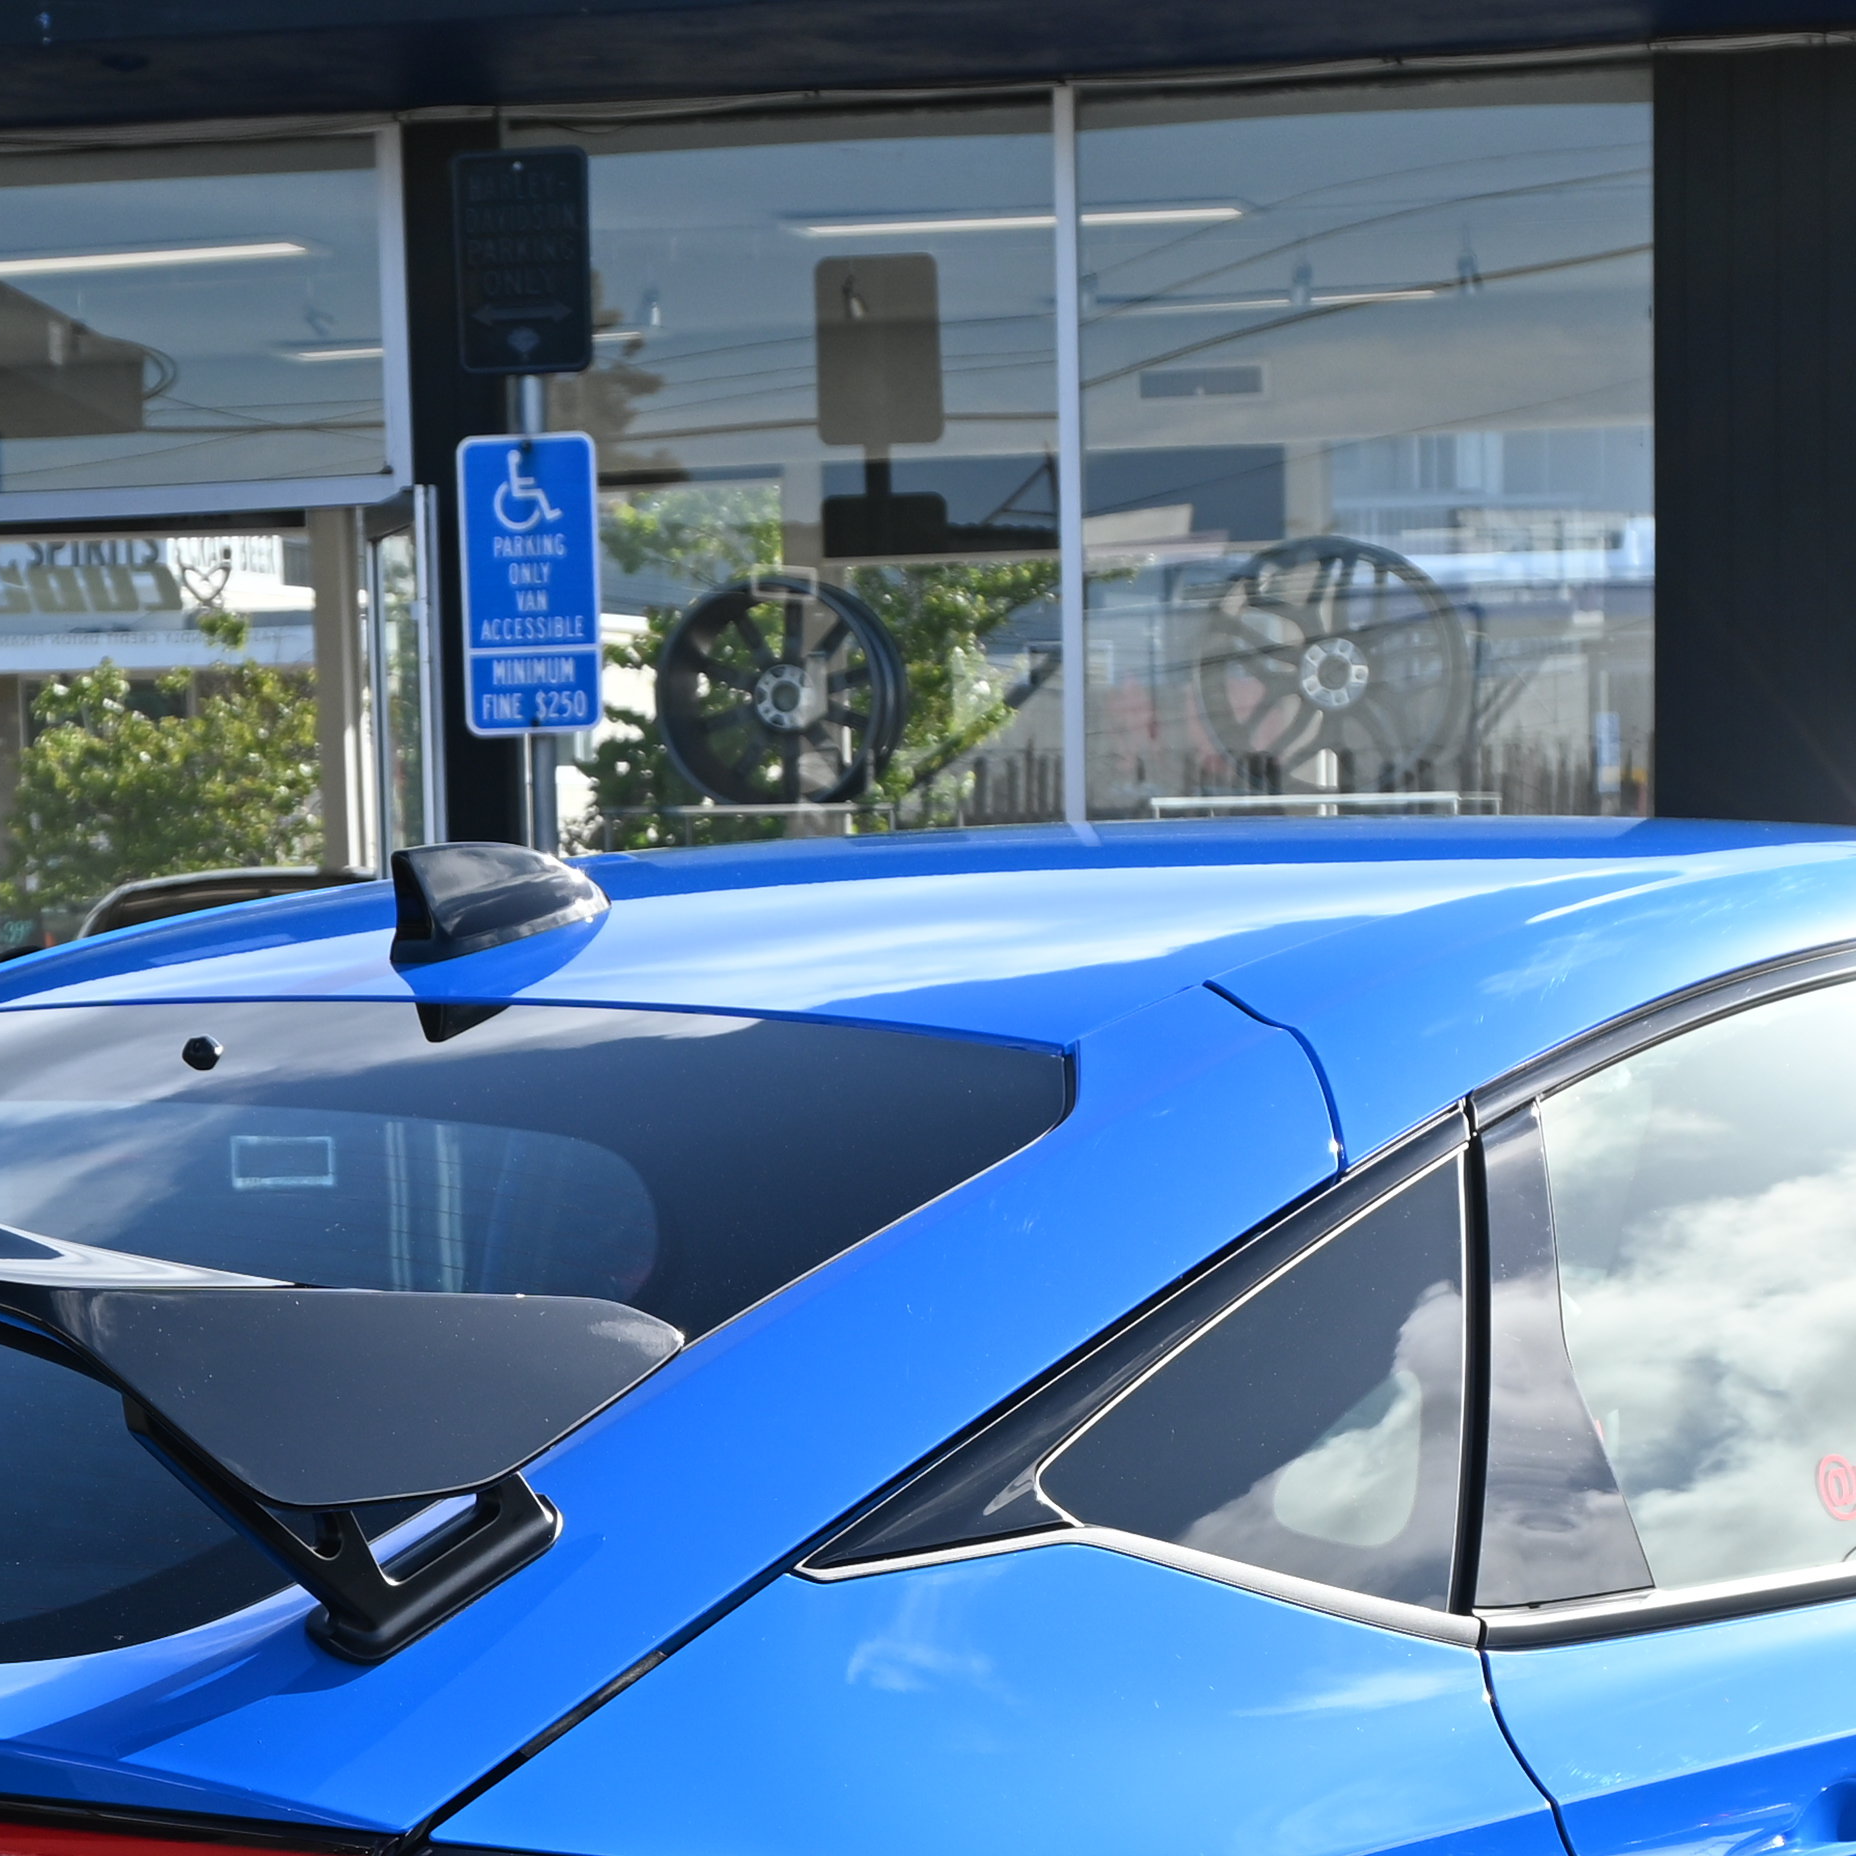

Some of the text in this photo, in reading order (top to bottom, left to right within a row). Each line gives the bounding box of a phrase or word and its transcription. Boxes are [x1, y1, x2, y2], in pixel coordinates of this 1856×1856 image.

[466, 235, 577, 266] PARKING
[481, 268, 558, 296] ONLY
[494, 534, 566, 557] PARKING
[508, 562, 550, 584] ONLY
[516, 590, 548, 611] VAN
[481, 615, 585, 640] ACCESSIBLE
[493, 657, 575, 684] MINIMUM
[482, 689, 587, 720] FINE $250
